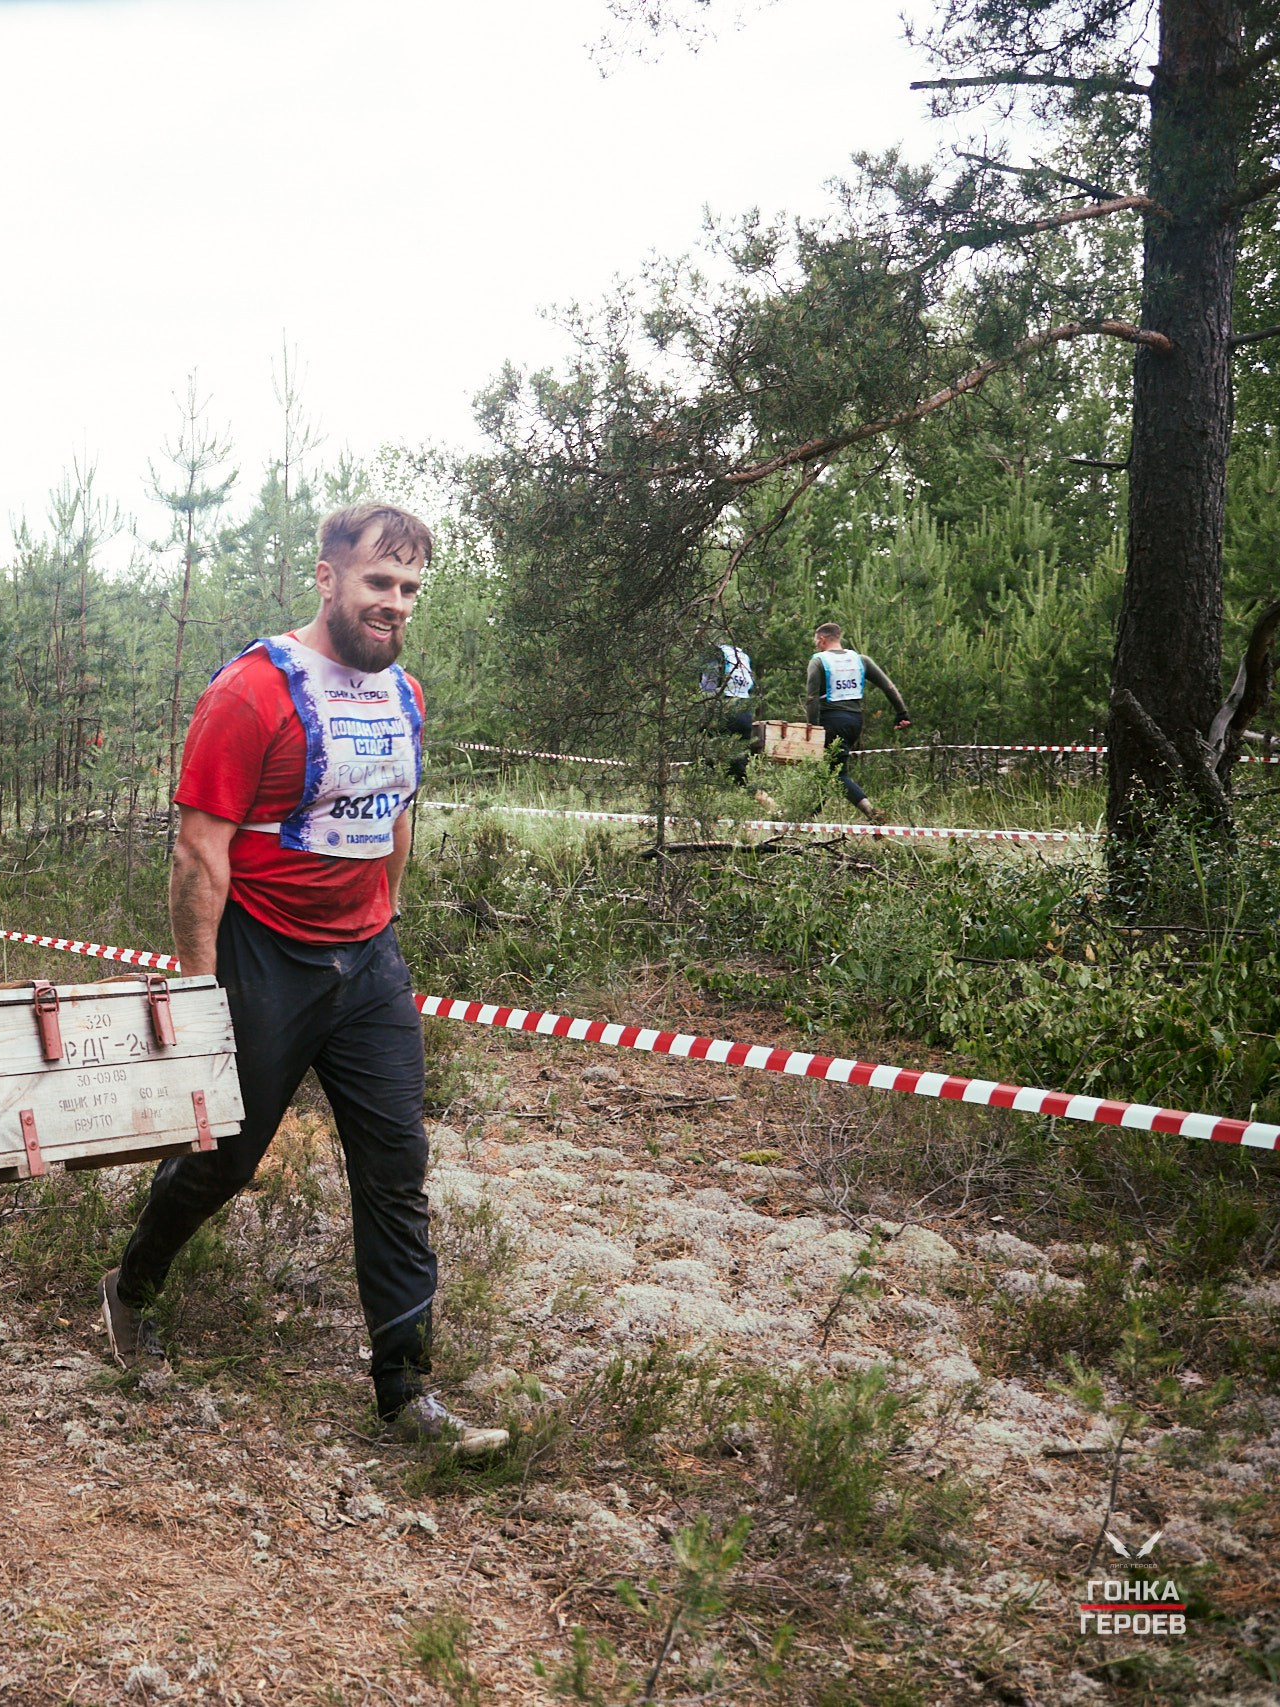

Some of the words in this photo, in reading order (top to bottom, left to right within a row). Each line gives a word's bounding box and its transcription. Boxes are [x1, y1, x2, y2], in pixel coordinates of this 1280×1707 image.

[835, 679, 857, 690] 5505
[355, 738, 390, 755] СТАРТ
[337, 764, 405, 788] РОМАН
[74, 1114, 113, 1131] БРУТТО
